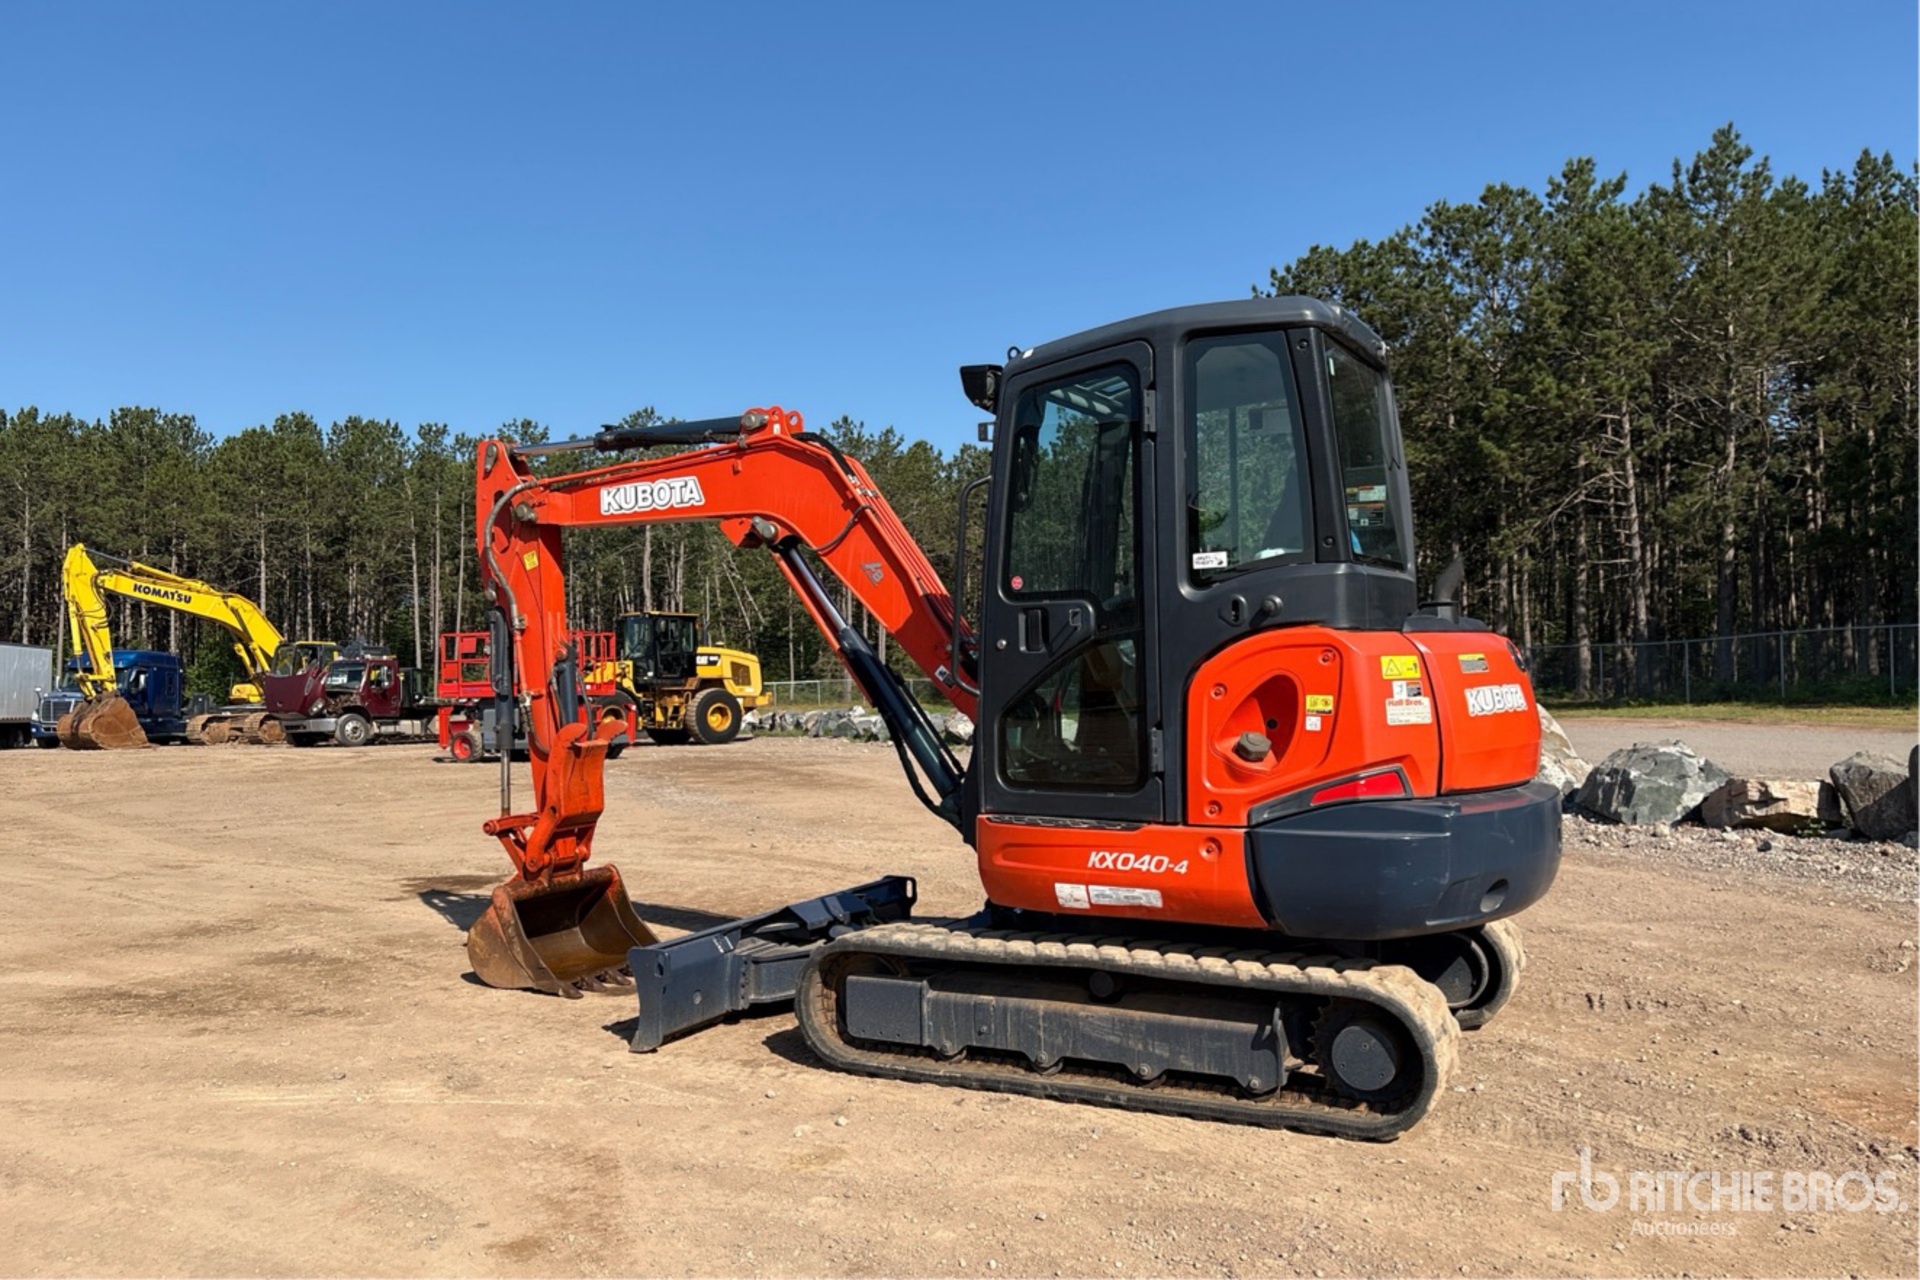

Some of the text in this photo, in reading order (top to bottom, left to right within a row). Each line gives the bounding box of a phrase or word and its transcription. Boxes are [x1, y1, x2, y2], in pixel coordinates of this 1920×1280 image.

[600, 476, 705, 515] KUBOTA
[133, 583, 192, 604] KOMATSU
[1464, 684, 1528, 717] KUBOTA
[1087, 851, 1189, 875] KX040-4
